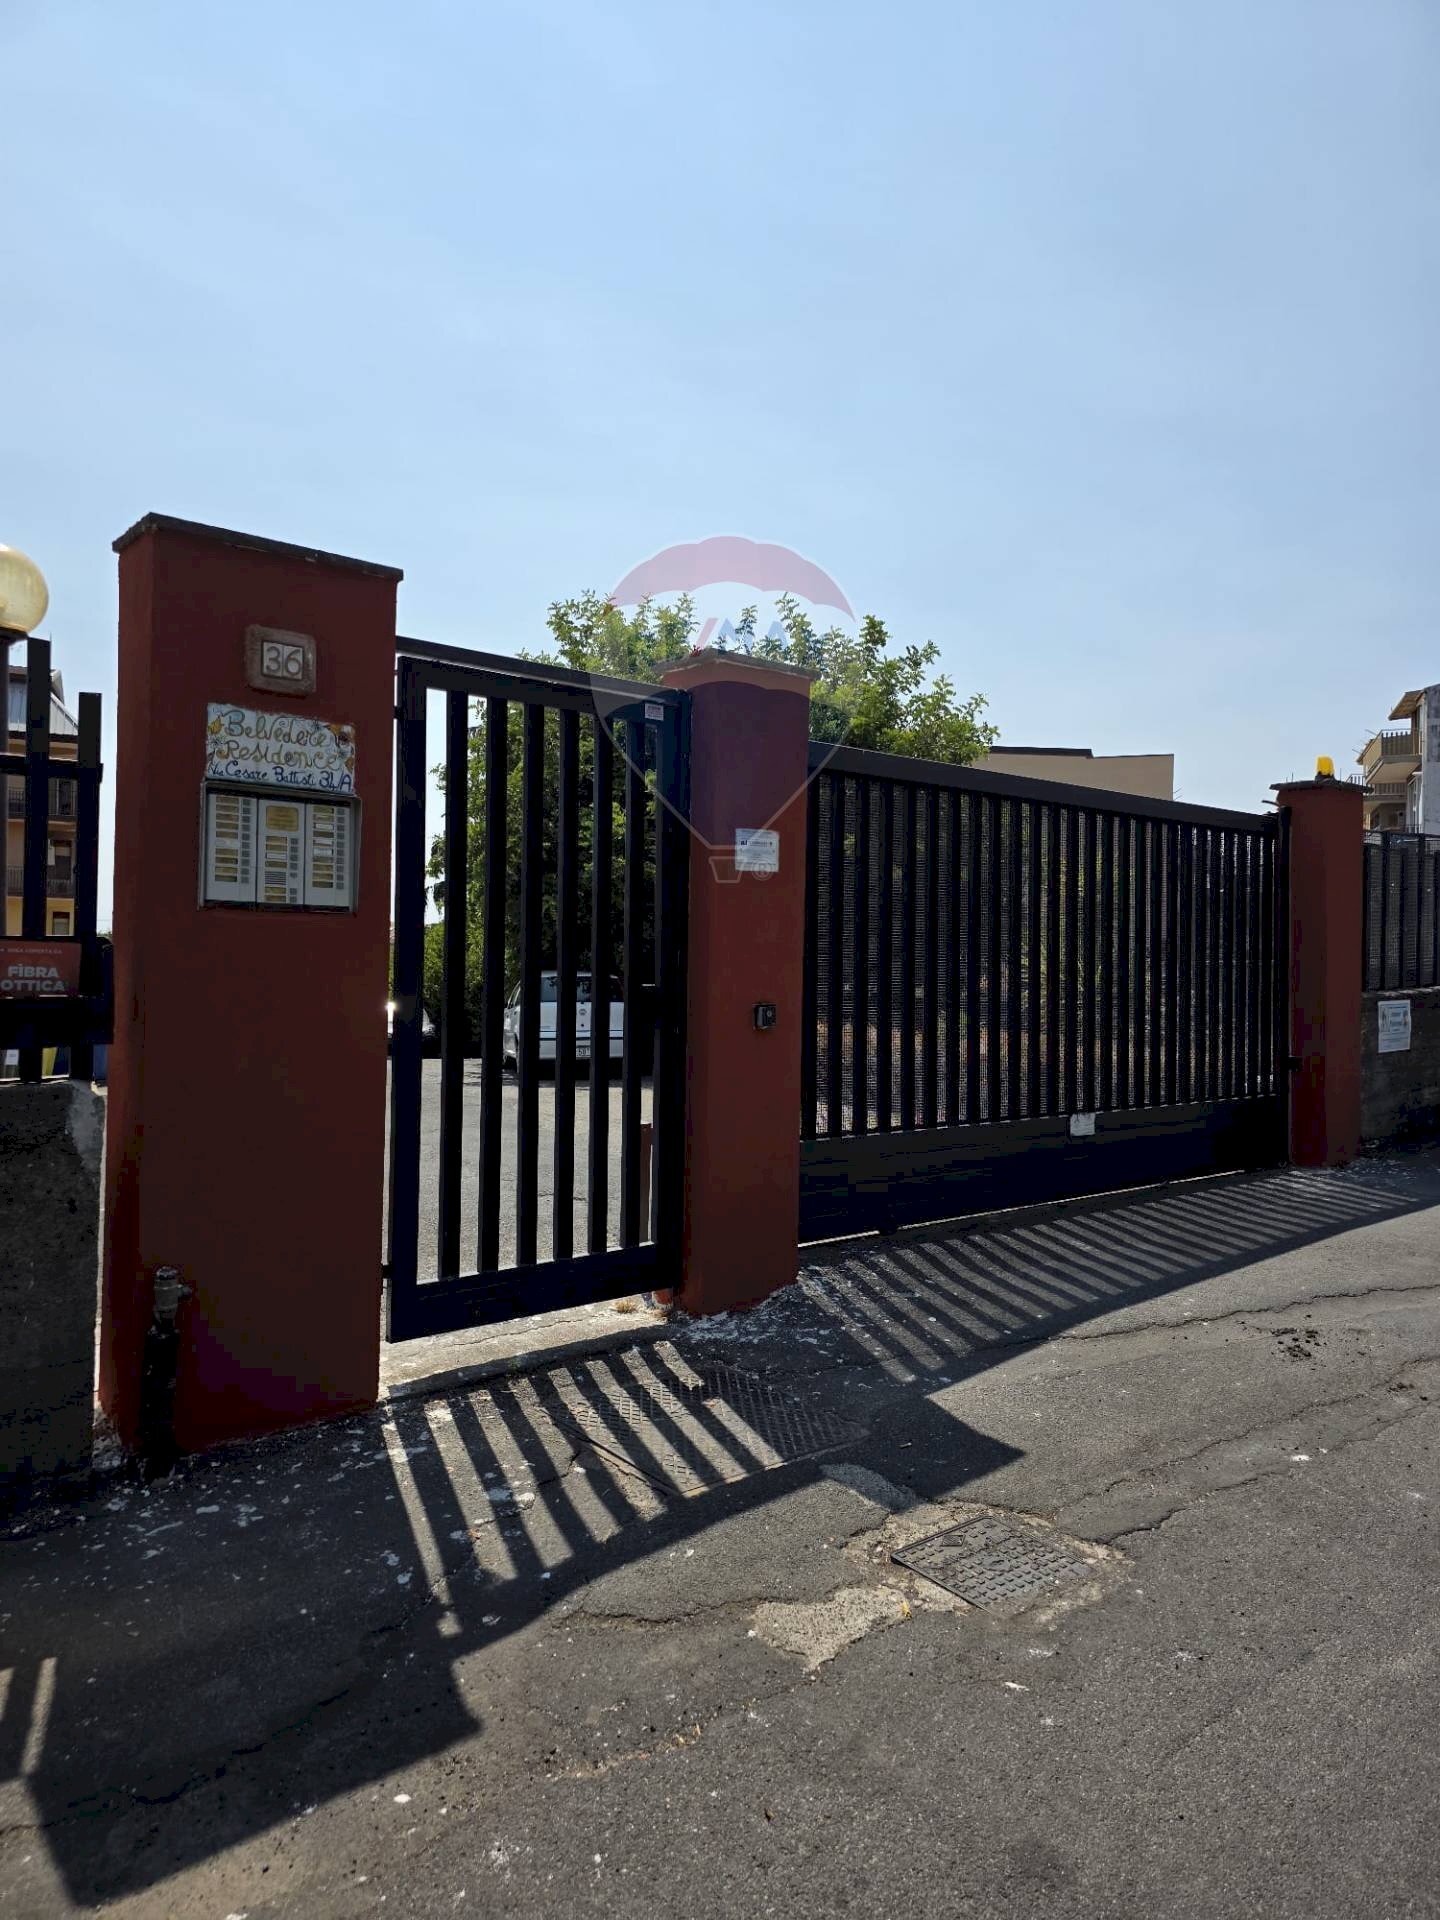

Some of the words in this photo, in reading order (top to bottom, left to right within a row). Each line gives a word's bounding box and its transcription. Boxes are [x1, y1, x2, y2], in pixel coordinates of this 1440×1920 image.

[266, 646, 302, 676] 36
[222, 709, 331, 748] Belvedere
[219, 739, 342, 771] Residence
[225, 760, 268, 781] Cesare
[273, 765, 315, 787] Battisti
[319, 769, 352, 793] 34/A
[0, 979, 65, 992] OTTICA
